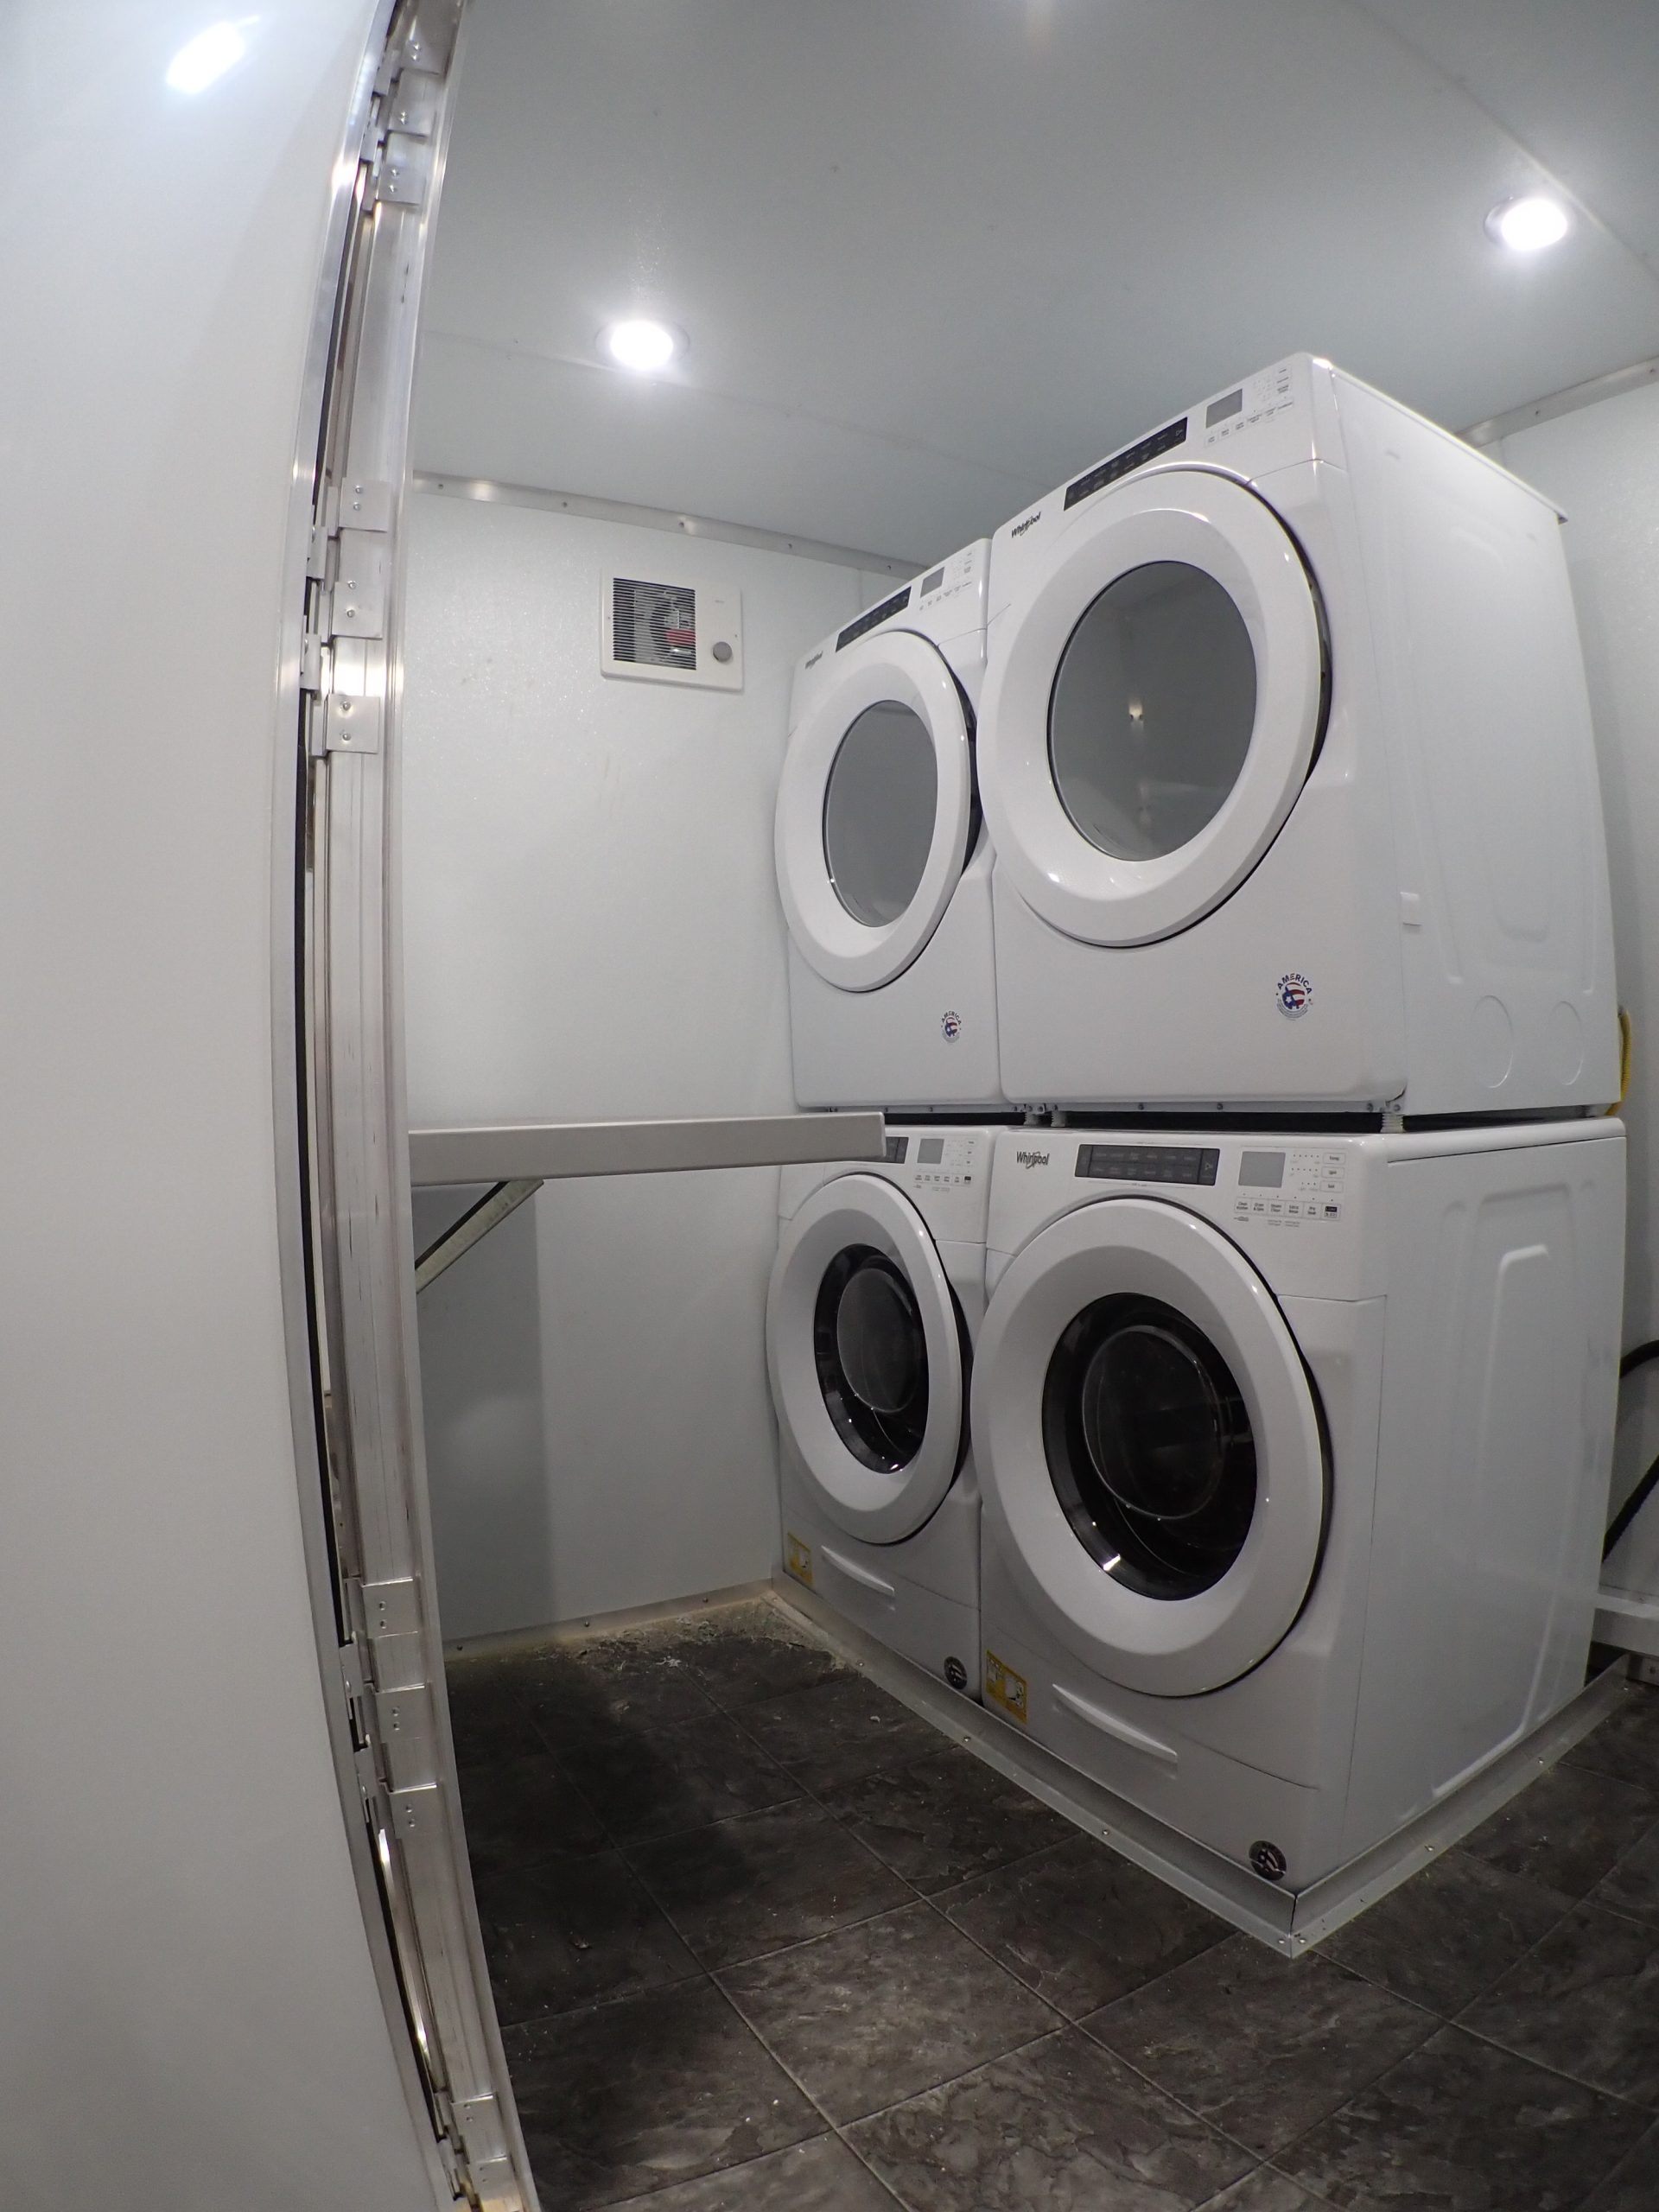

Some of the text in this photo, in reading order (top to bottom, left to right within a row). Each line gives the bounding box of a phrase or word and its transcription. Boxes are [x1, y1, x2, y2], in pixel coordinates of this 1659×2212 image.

[1011, 511, 1041, 538] Whirlpool
[1277, 973, 1313, 995] AMERICA
[1016, 1151, 1050, 1169] Whirlpool
